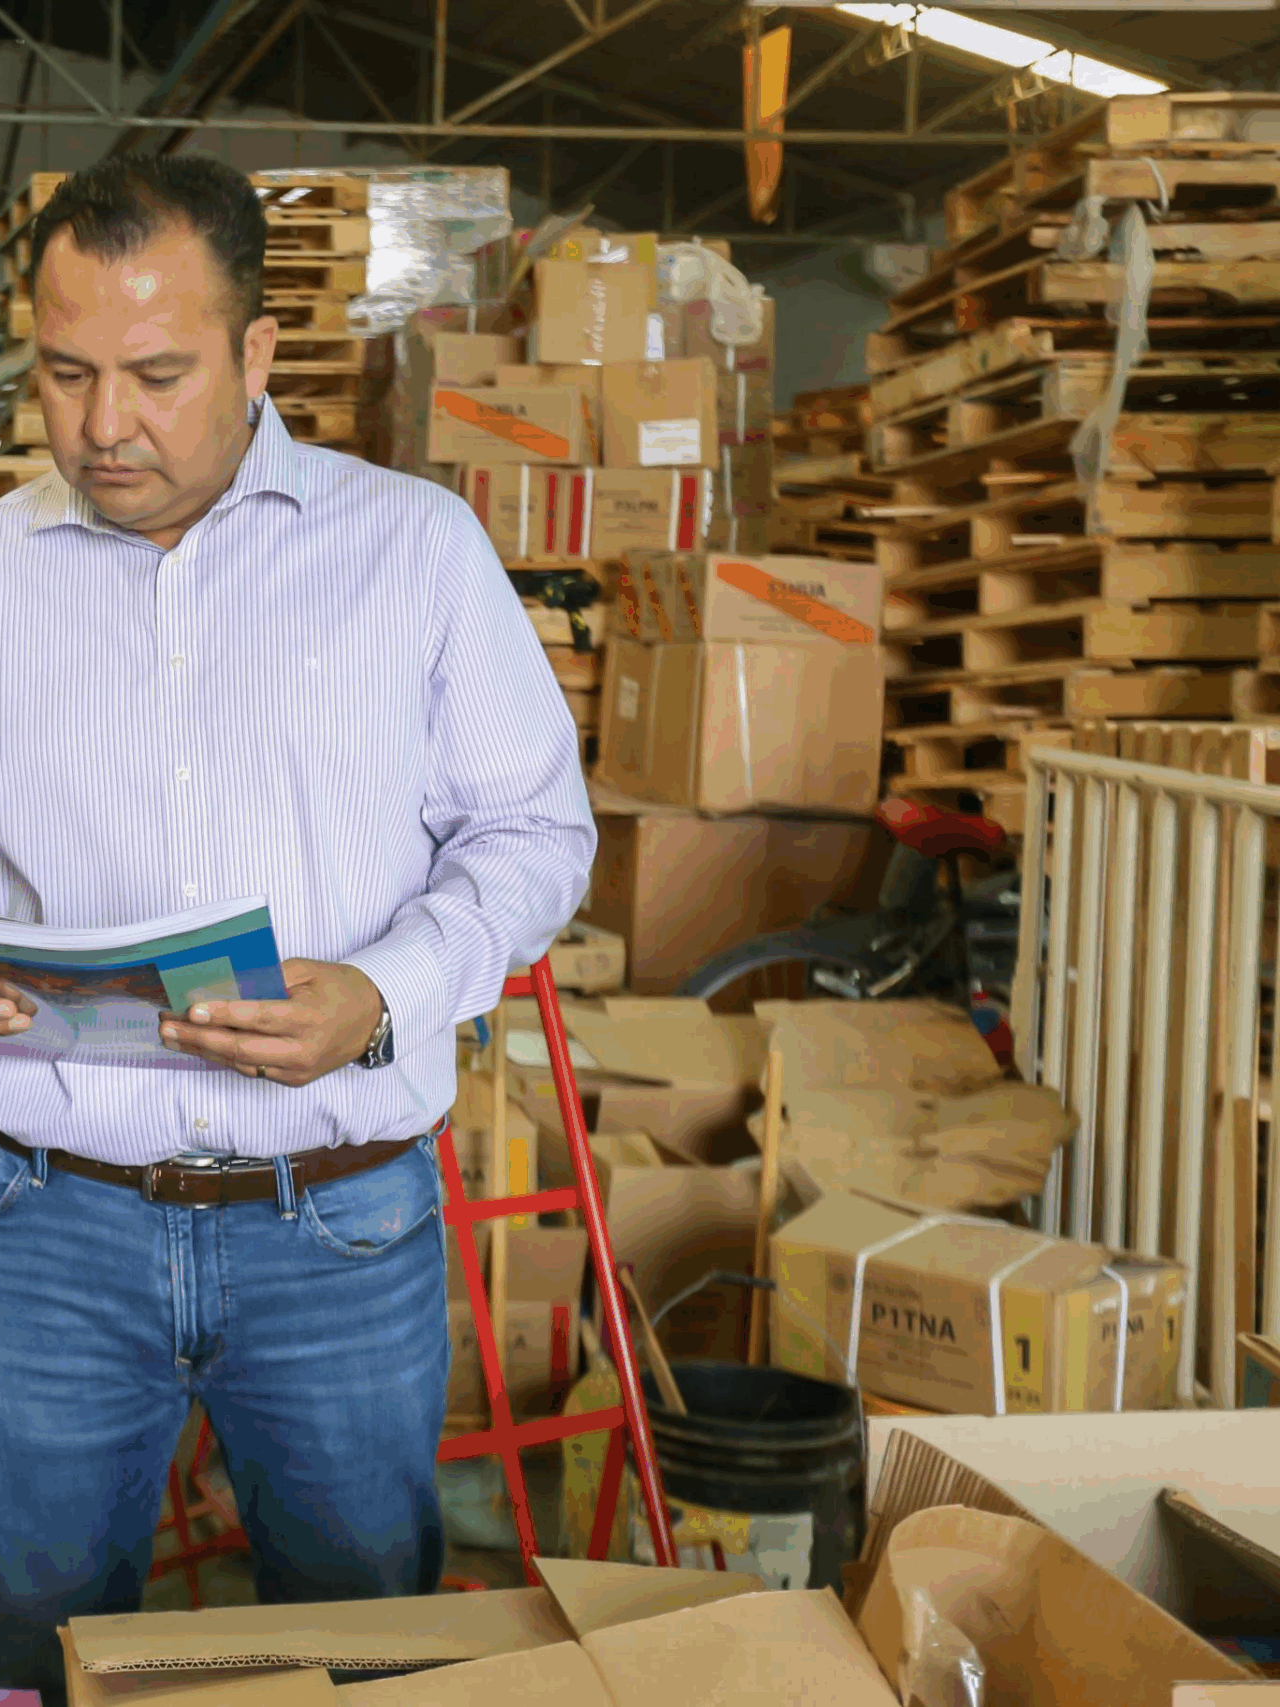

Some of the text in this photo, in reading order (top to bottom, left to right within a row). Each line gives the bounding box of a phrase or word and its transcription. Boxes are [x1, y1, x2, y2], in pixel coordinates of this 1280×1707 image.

[871, 1301, 957, 1345] P1TNA
[1100, 1315, 1145, 1342] P1NA
[1014, 1333, 1031, 1373] 1
